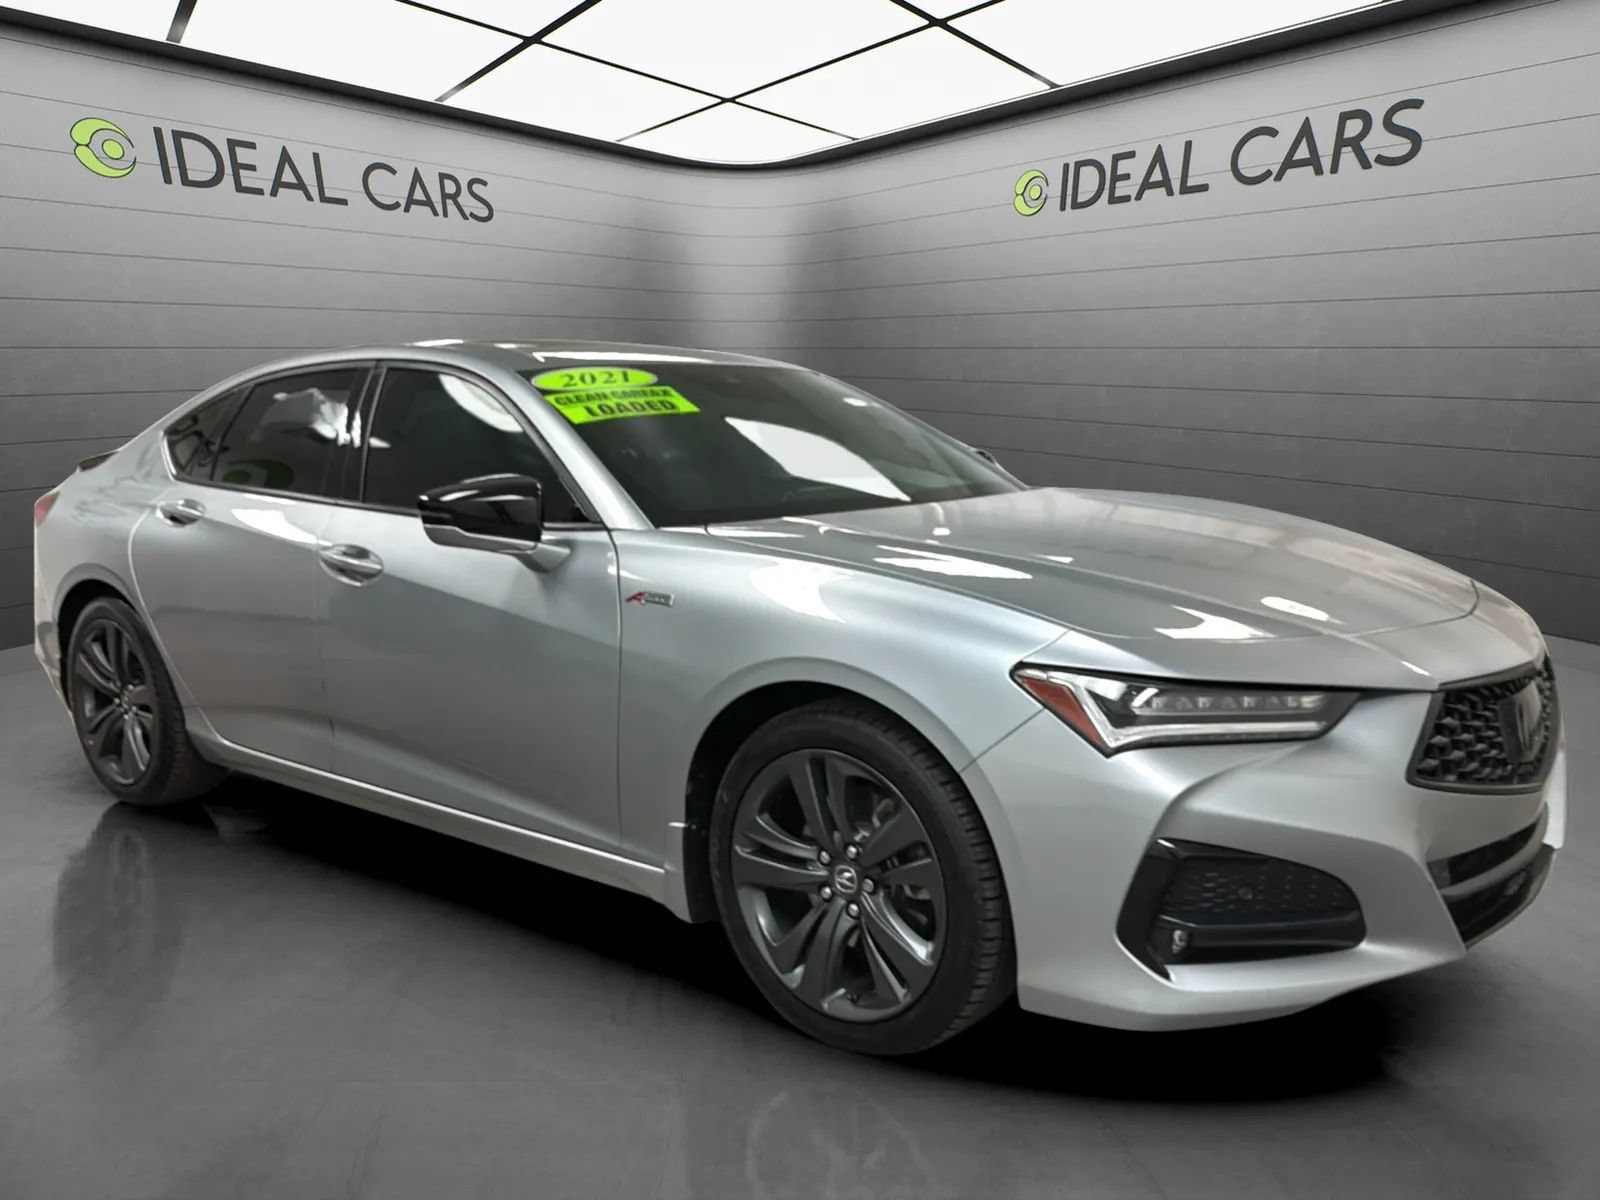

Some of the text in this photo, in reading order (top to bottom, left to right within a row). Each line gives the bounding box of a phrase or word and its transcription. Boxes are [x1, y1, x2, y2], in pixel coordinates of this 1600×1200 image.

[1059, 98, 1425, 212] IDEAL CARS
[153, 126, 495, 223] IDEAL CARS
[561, 370, 631, 388] 2021
[555, 390, 608, 406] CLEAN
[585, 399, 677, 417] LOADED
